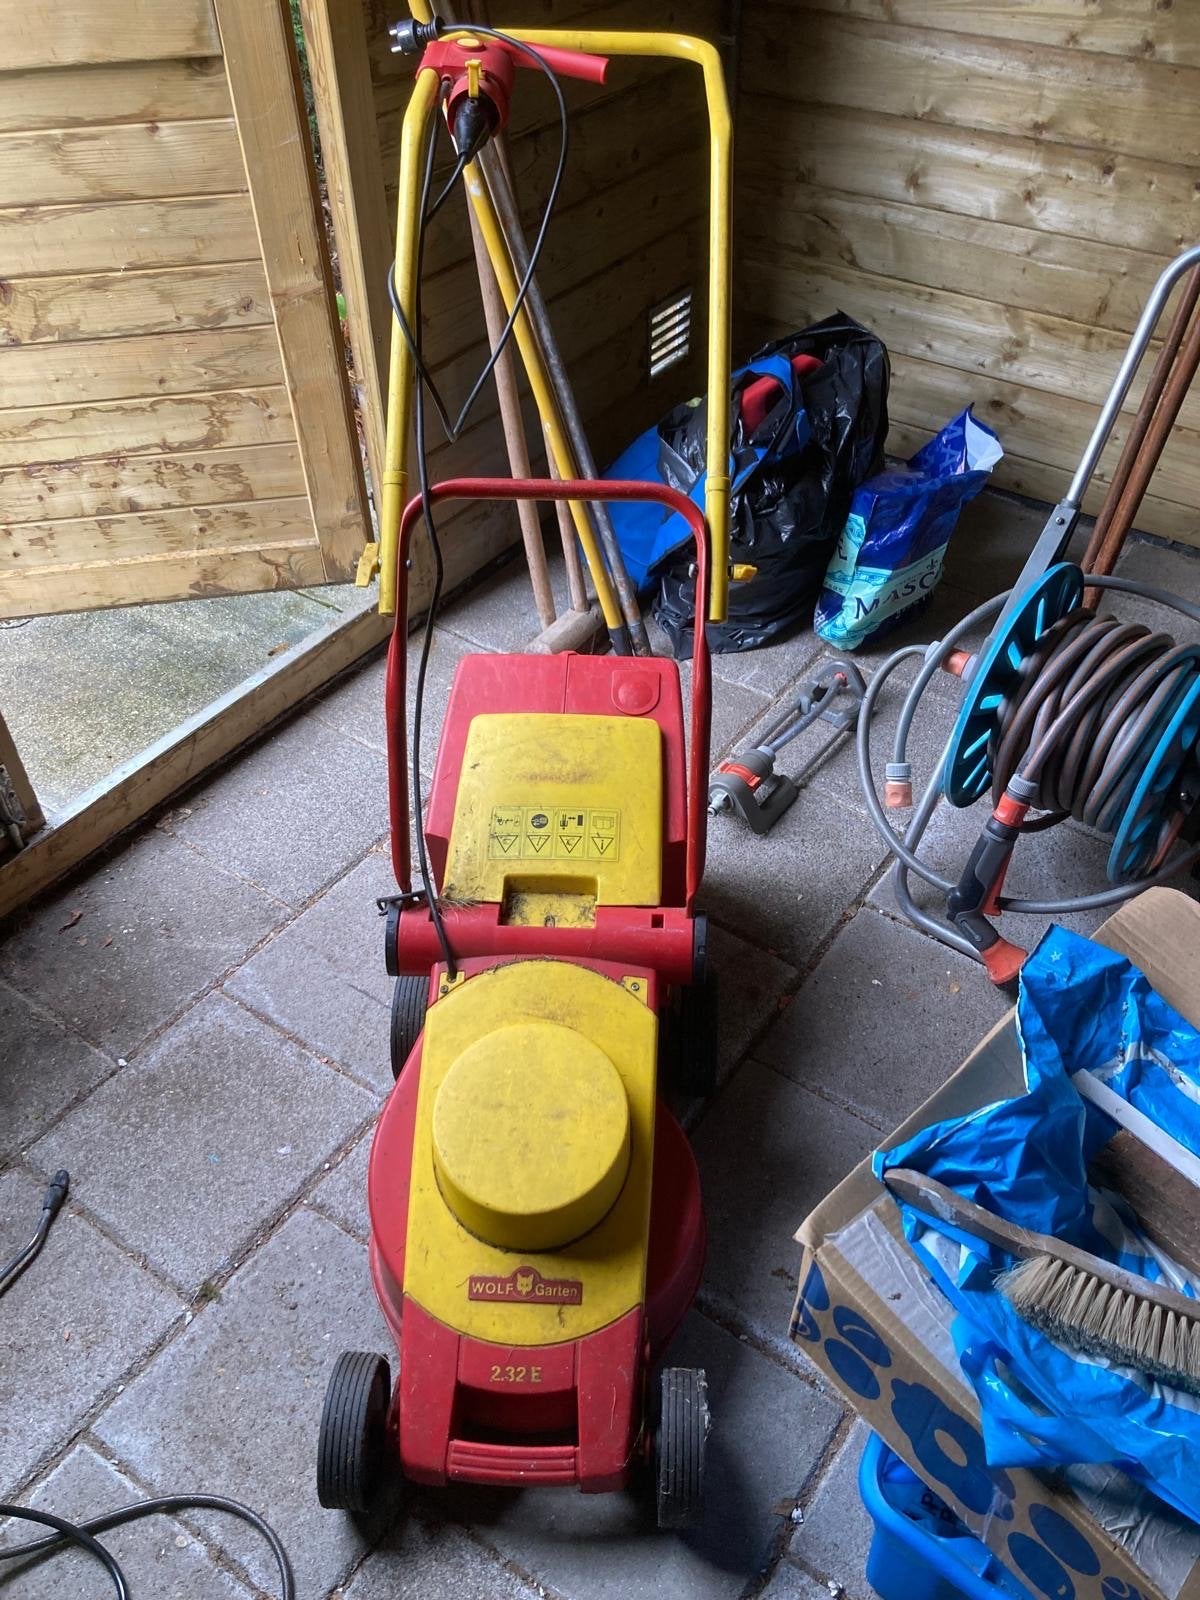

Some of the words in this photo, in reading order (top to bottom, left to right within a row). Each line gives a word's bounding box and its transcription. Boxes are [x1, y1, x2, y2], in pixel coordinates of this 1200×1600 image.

[472, 1282, 514, 1295] WOLF
[535, 1284, 578, 1297] Garten
[490, 1365, 526, 1383] 2.32
[531, 1366, 542, 1383] E
